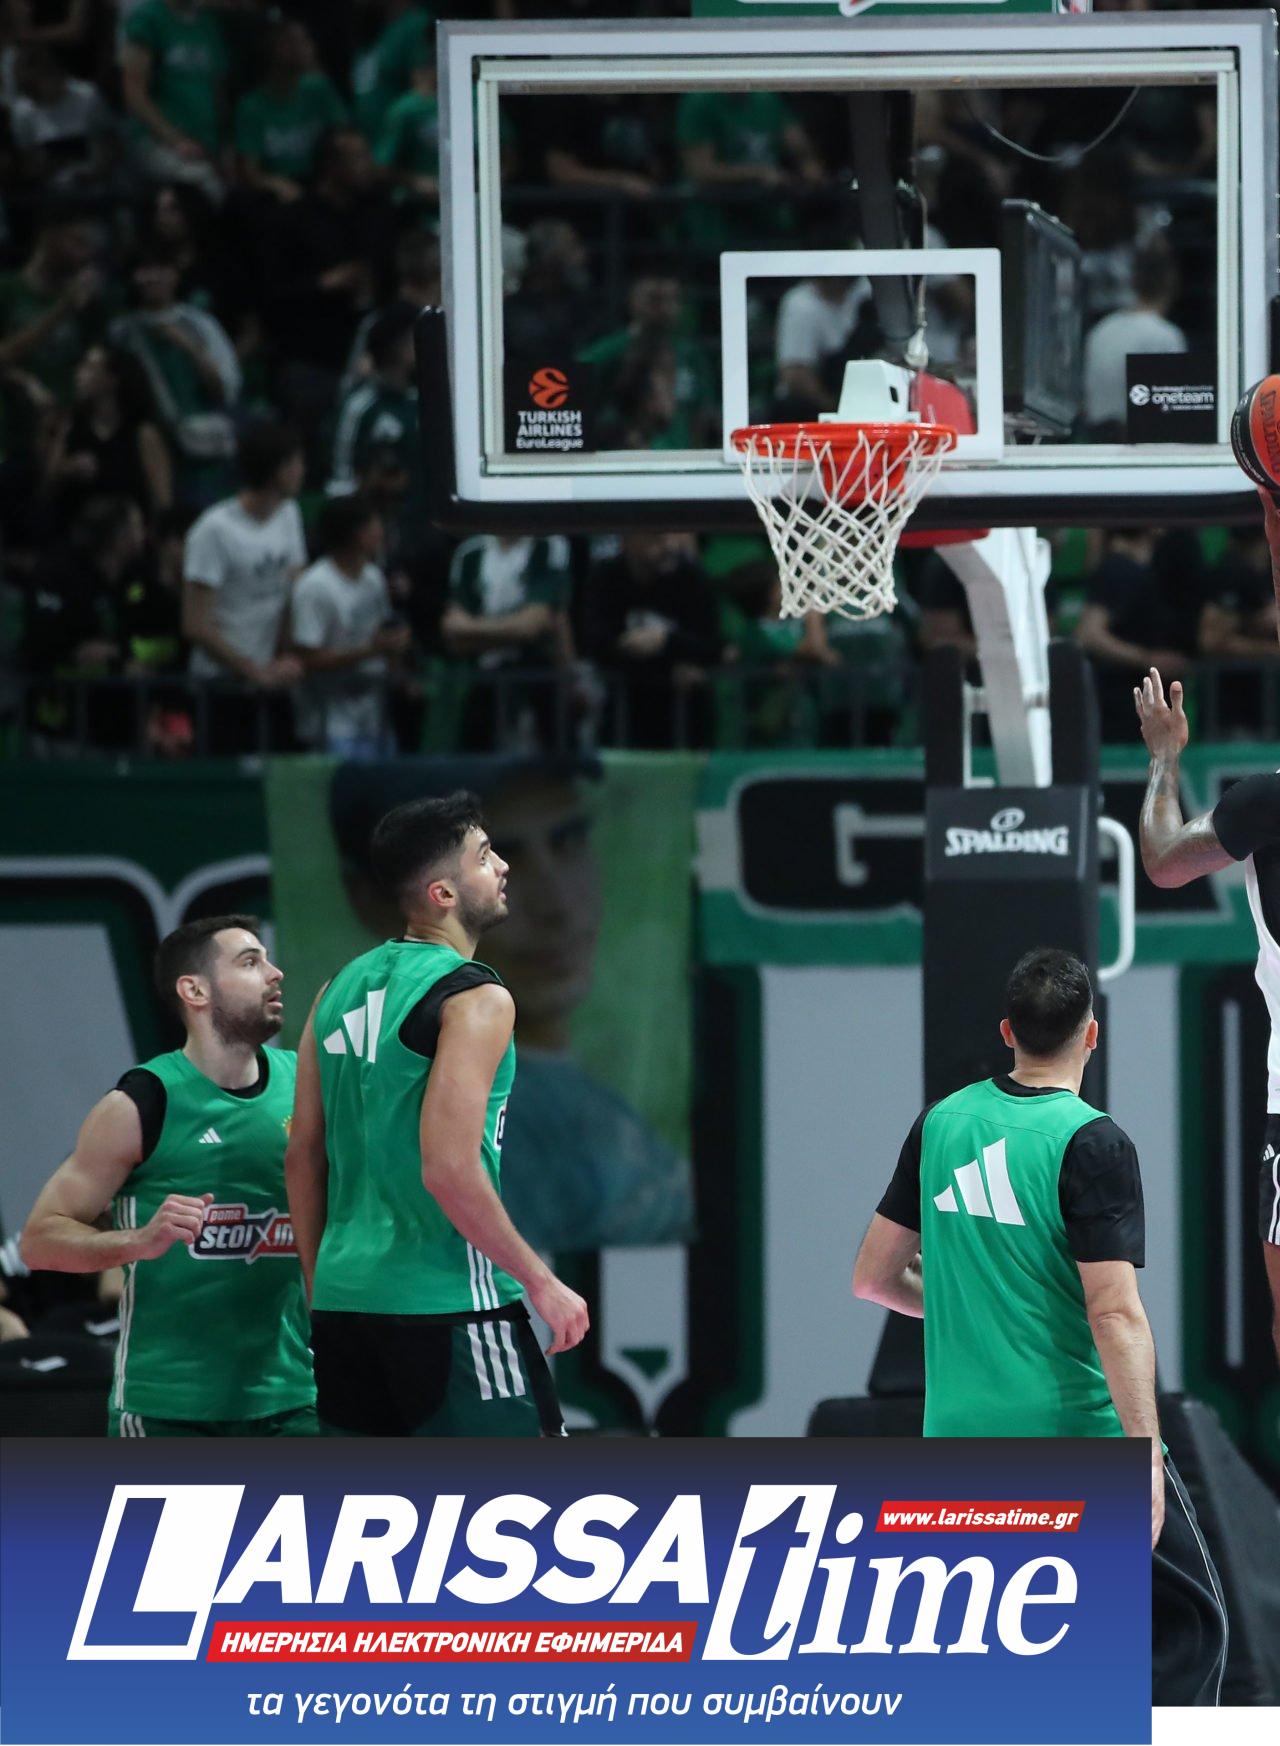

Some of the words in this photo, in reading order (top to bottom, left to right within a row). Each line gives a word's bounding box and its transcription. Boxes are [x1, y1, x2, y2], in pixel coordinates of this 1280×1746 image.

[1151, 392, 1215, 405] oneteam
[518, 410, 582, 424] TURKISH
[517, 423, 583, 437] AIRLINES
[944, 826, 1070, 857] SPALDING
